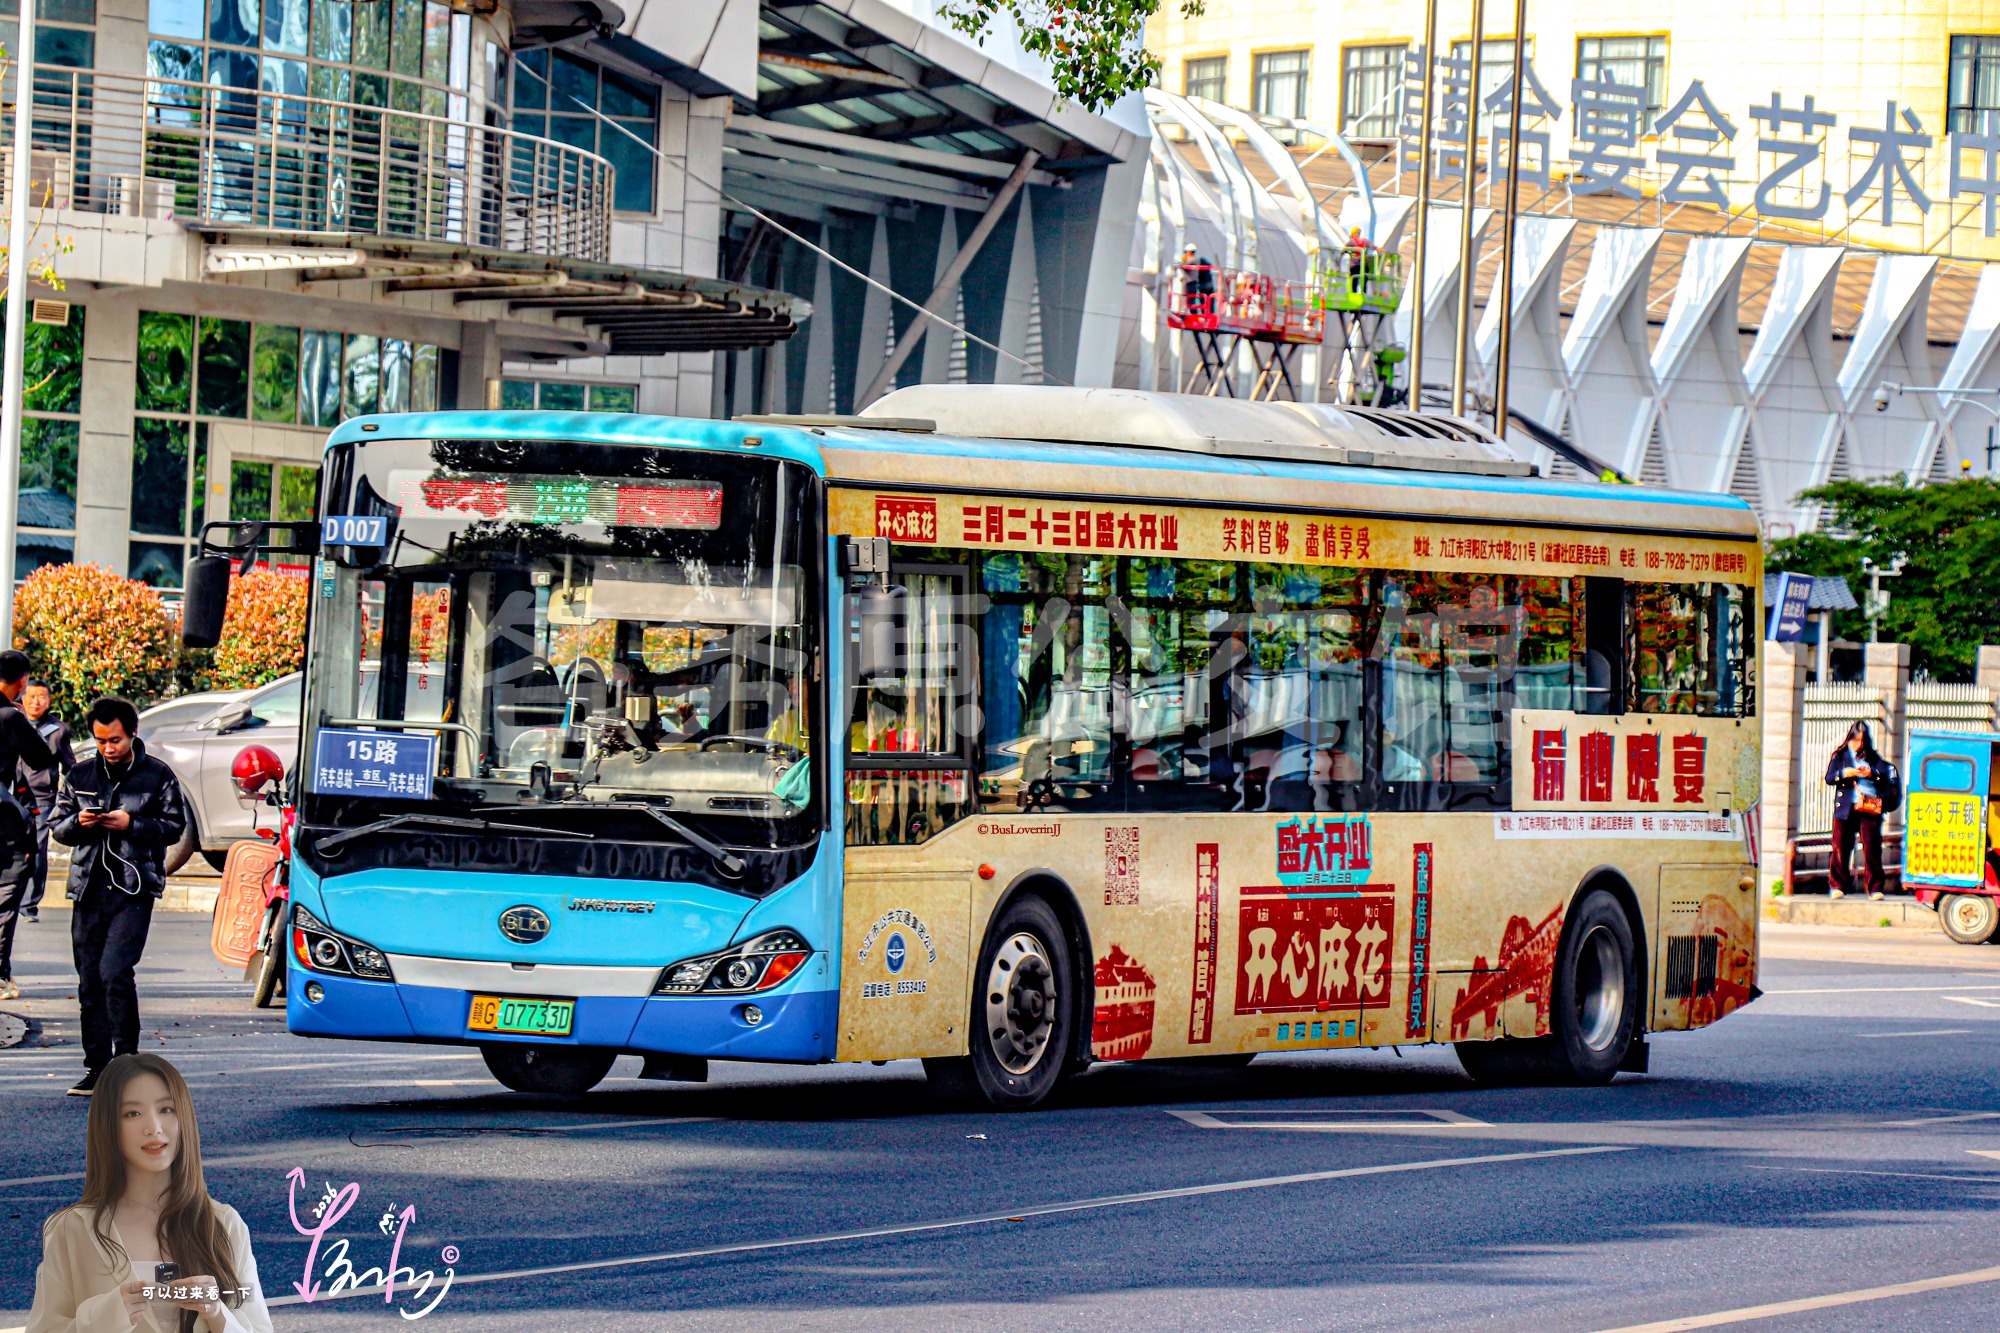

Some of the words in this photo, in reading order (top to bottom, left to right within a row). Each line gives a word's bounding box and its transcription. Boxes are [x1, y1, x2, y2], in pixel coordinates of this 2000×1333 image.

[326, 519, 338, 541] D
[343, 520, 380, 542] 007
[878, 510, 935, 539] 开心麻花
[963, 504, 1178, 551] 三月二十三日盛大开业
[1222, 517, 1290, 555] 笑料管够
[1305, 523, 1370, 560] 盡情享受
[418, 615, 431, 690] 防止夹伤
[347, 740, 398, 765] 15路
[1532, 725, 1708, 803] 偷心晚宴
[319, 767, 353, 789] 汽车总站
[362, 769, 380, 782] 市区
[388, 772, 425, 794] 汽车总站
[1949, 802, 1975, 826] 开锁
[1276, 814, 1371, 873] 盛大开业
[1306, 873, 1352, 884] 三月二十三日
[234, 888, 255, 949] 吉祥如意
[858, 908, 937, 965] 九江市公共交通集团公司
[1244, 920, 1388, 1003] 开心麻花
